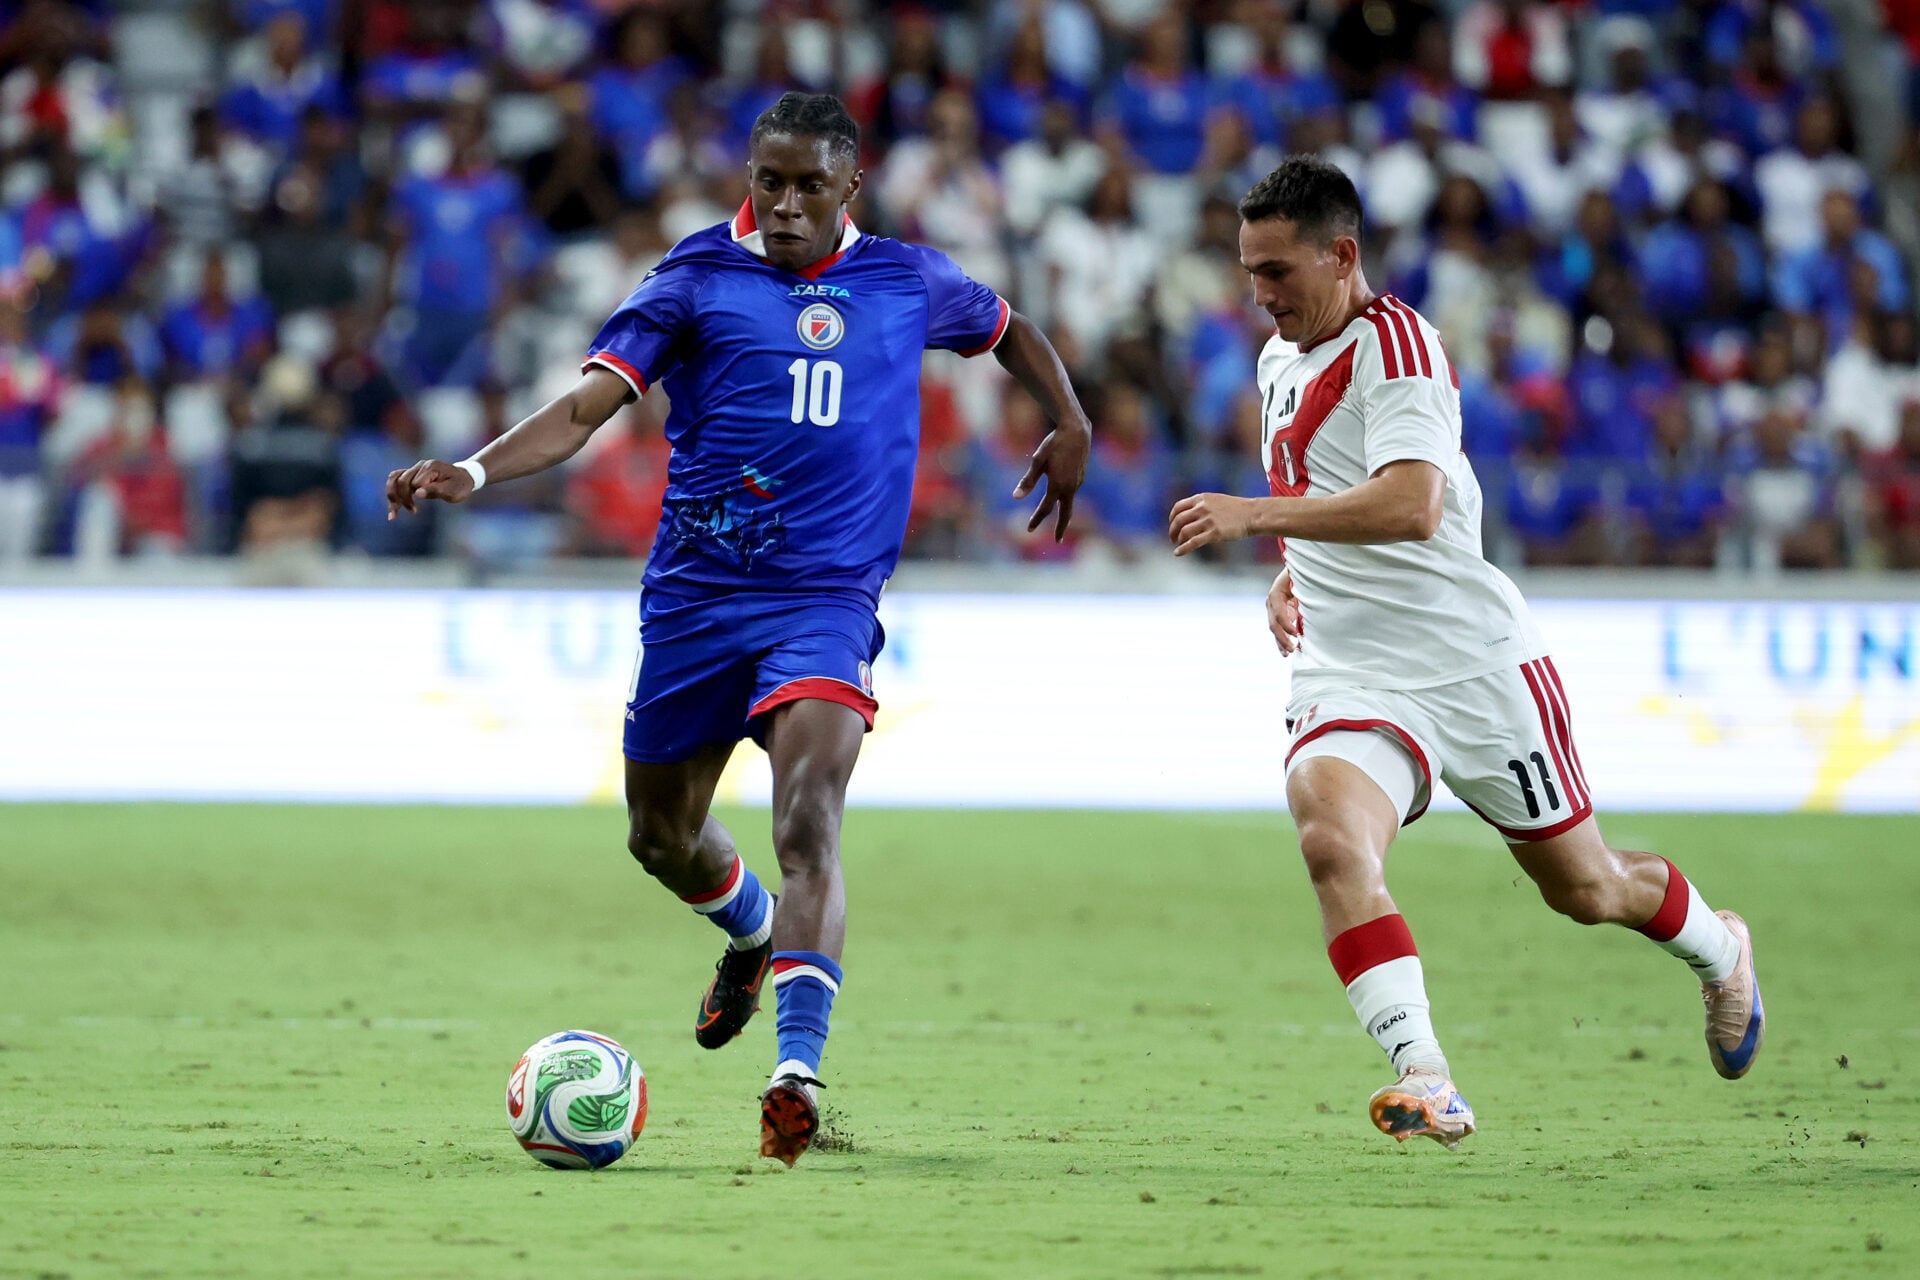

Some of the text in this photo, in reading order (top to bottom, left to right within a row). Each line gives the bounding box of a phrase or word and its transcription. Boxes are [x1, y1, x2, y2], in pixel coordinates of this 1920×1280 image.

[787, 284, 850, 297] SAETA
[788, 358, 843, 427] 10
[1508, 751, 1560, 819] 11
